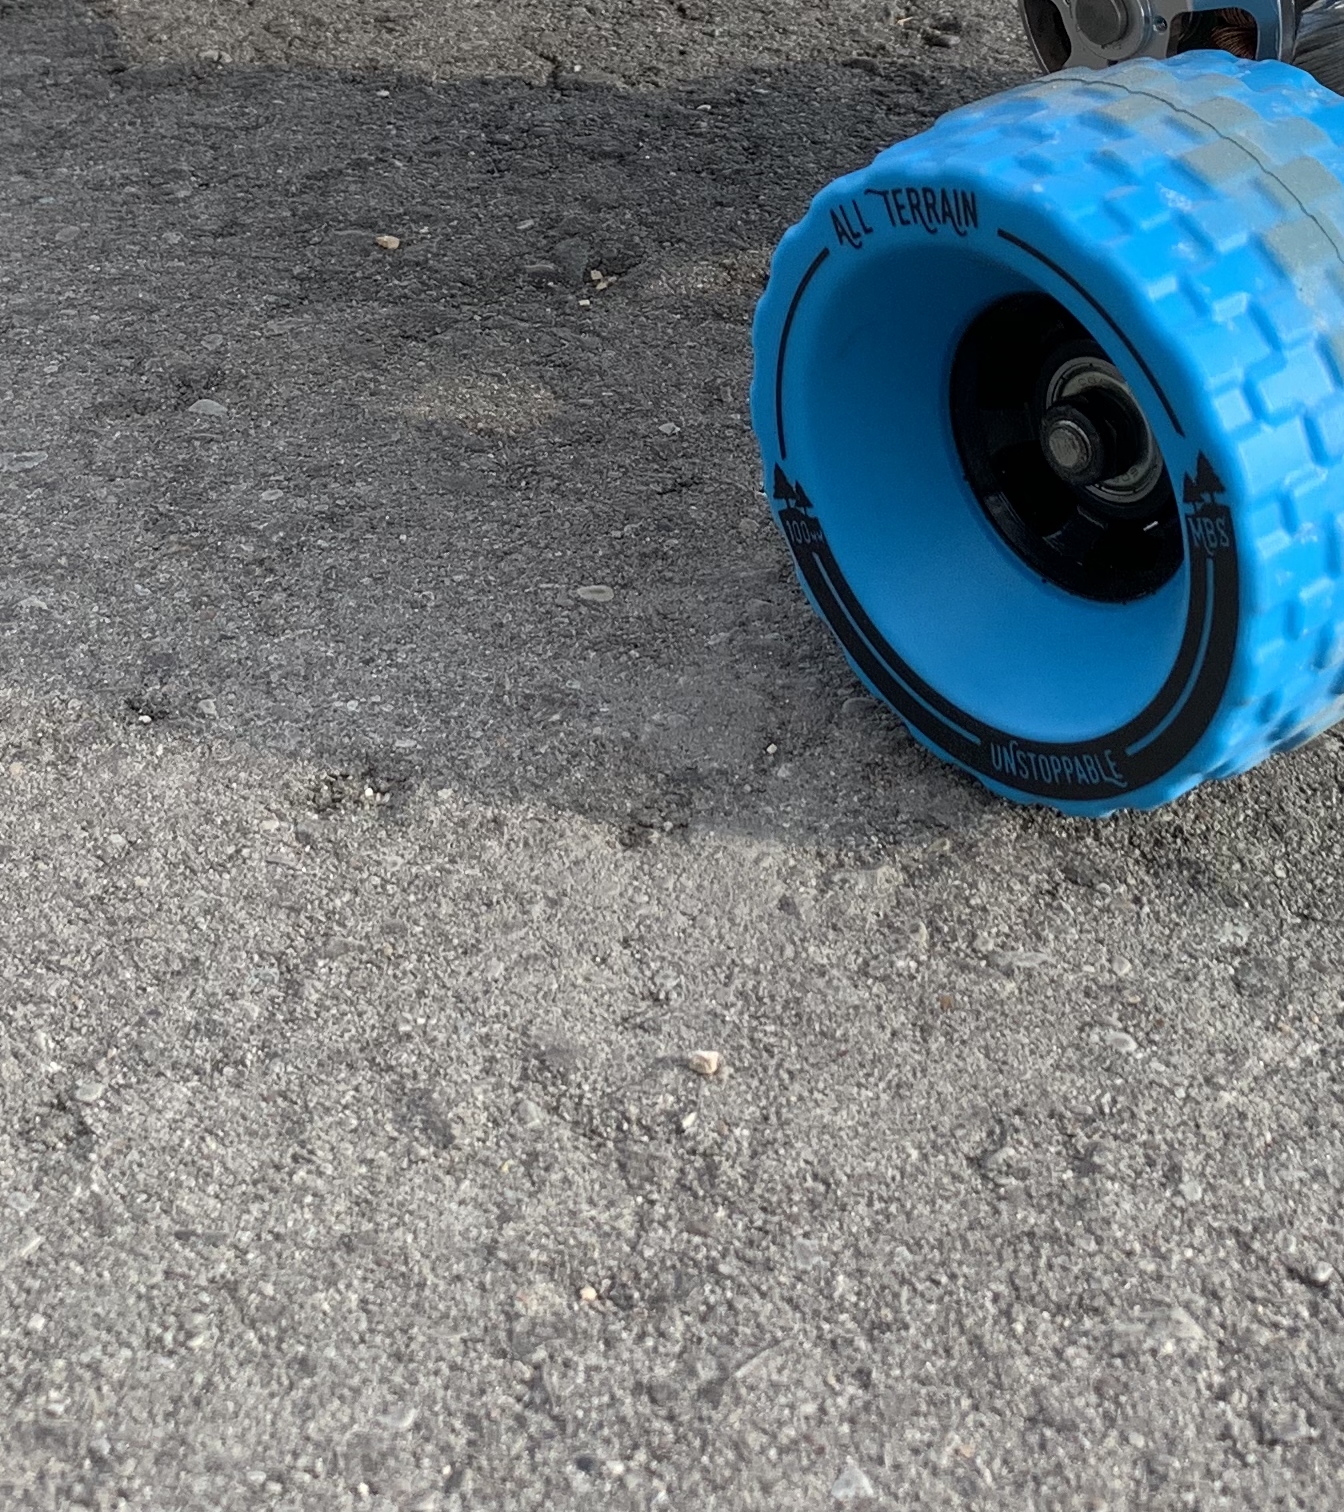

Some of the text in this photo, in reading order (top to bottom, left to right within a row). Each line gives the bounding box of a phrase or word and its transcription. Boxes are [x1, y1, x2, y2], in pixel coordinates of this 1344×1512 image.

[829, 187, 979, 250] ALL TERRAIN
[1186, 516, 1231, 556] MBS
[990, 739, 1129, 789] UNSTOPPABLE
